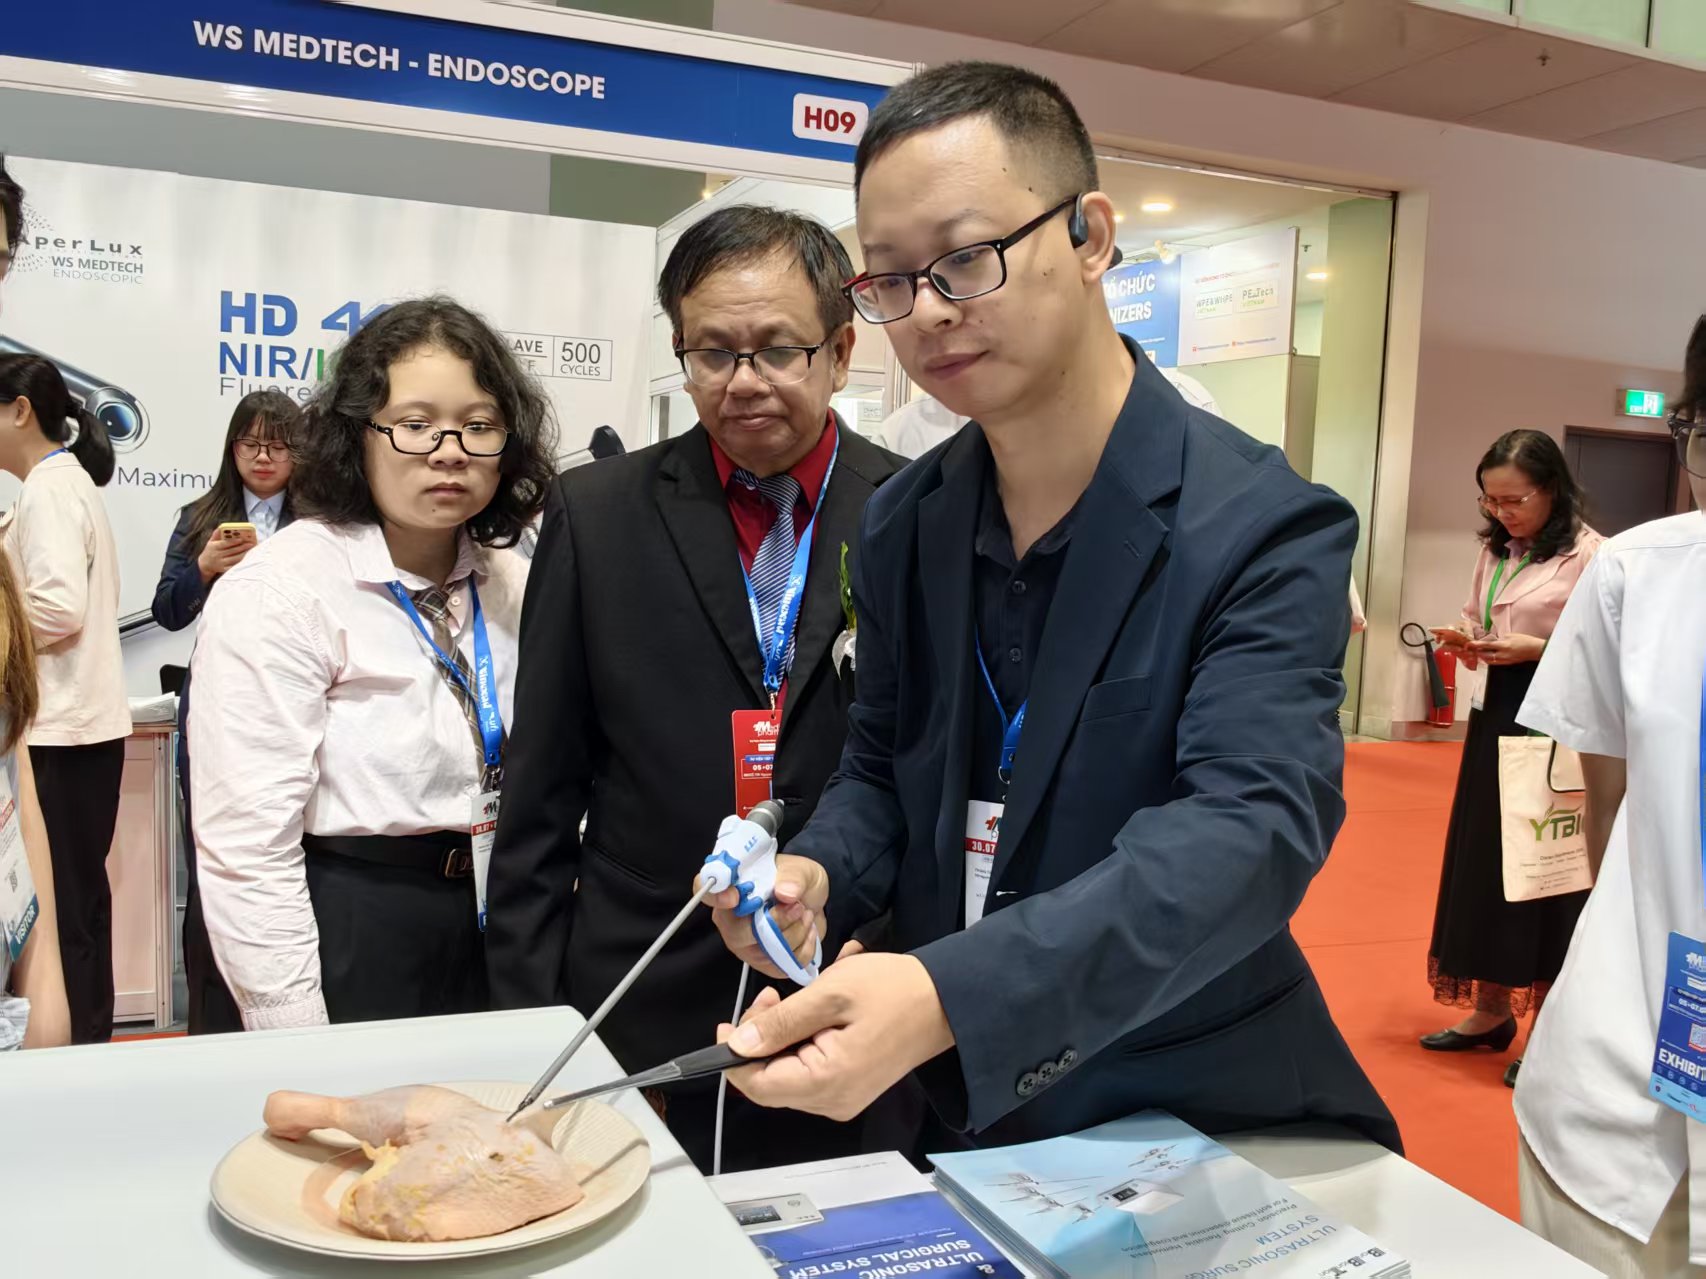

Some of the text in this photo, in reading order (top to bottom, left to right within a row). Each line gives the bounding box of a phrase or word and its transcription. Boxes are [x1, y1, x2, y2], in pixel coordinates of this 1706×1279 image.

[193, 20, 243, 50] WS
[254, 28, 400, 71] MEDTECH
[428, 52, 605, 99] ENDOSCOPE
[804, 105, 856, 134] H09
[21, 234, 143, 256] perLux
[52, 256, 143, 273] WS MEDTECH
[53, 269, 143, 284] ENDOSCOPIC
[220, 290, 298, 336] HD
[513, 339, 544, 353] AVE
[561, 341, 601, 364] 500
[219, 341, 326, 381] NIR/I
[560, 363, 601, 376] CYCLES
[118, 466, 214, 488] Maximu
[1528, 813, 1585, 841] YTBI
[1658, 1047, 1706, 1082] EXHIBIT
[1256, 1215, 1319, 1245] SYSTEM
[872, 1240, 971, 1264] SURGICAL
[1185, 1225, 1337, 1279] ULTRASONIC SURG
[789, 1257, 871, 1279] SYSTEM
[859, 1252, 984, 1279] ULTRASONIC
